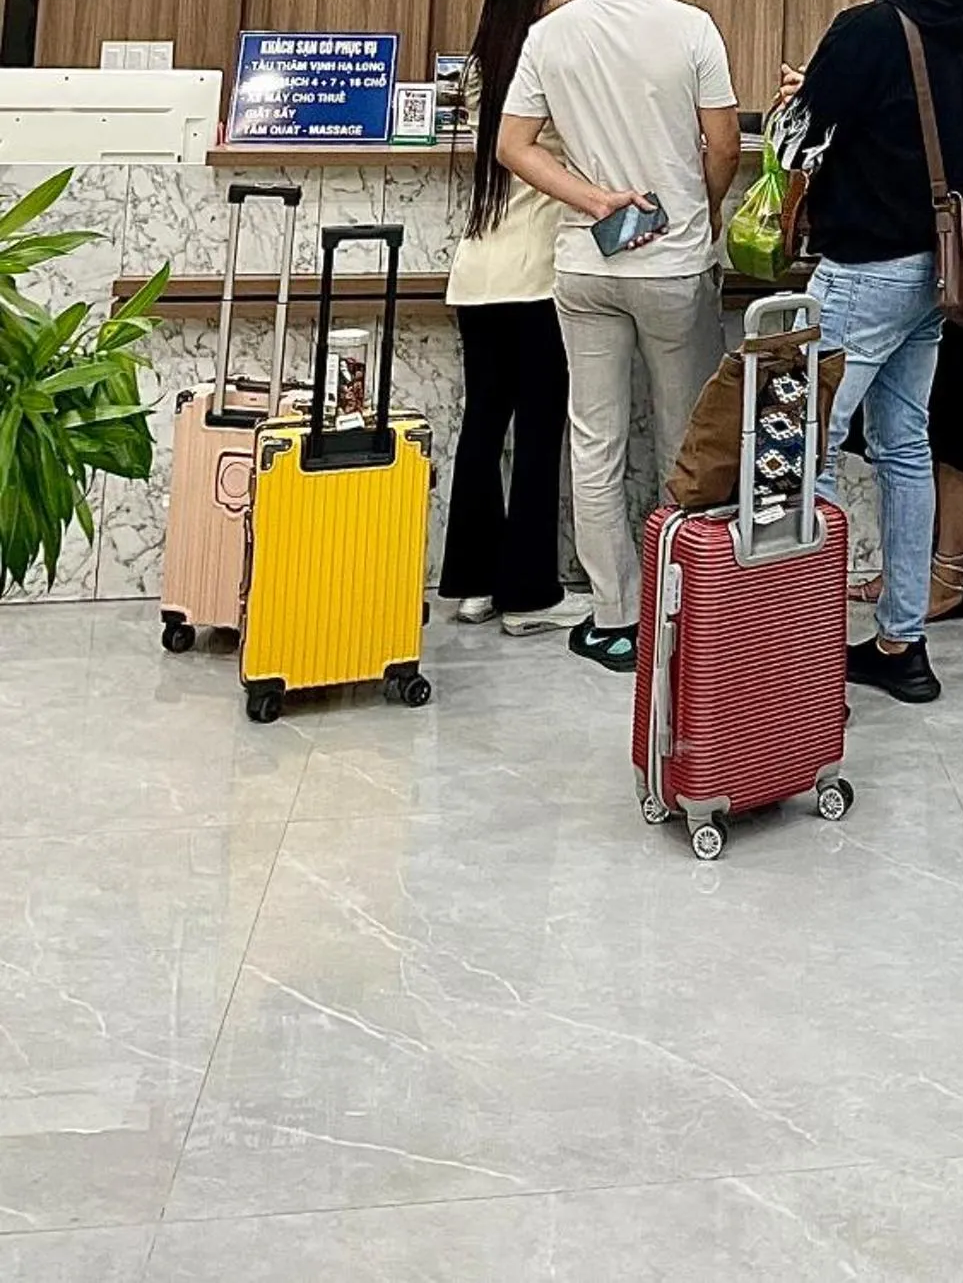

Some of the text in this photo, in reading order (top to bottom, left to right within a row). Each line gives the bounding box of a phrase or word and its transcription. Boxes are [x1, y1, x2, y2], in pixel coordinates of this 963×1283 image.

[251, 59, 274, 71] TÀU
[338, 61, 352, 74] HẠ
[355, 61, 385, 72] LONG
[311, 78, 318, 86] 4
[330, 78, 337, 87] 7
[292, 92, 315, 103] CHO
[309, 124, 363, 135] MASSAGE
